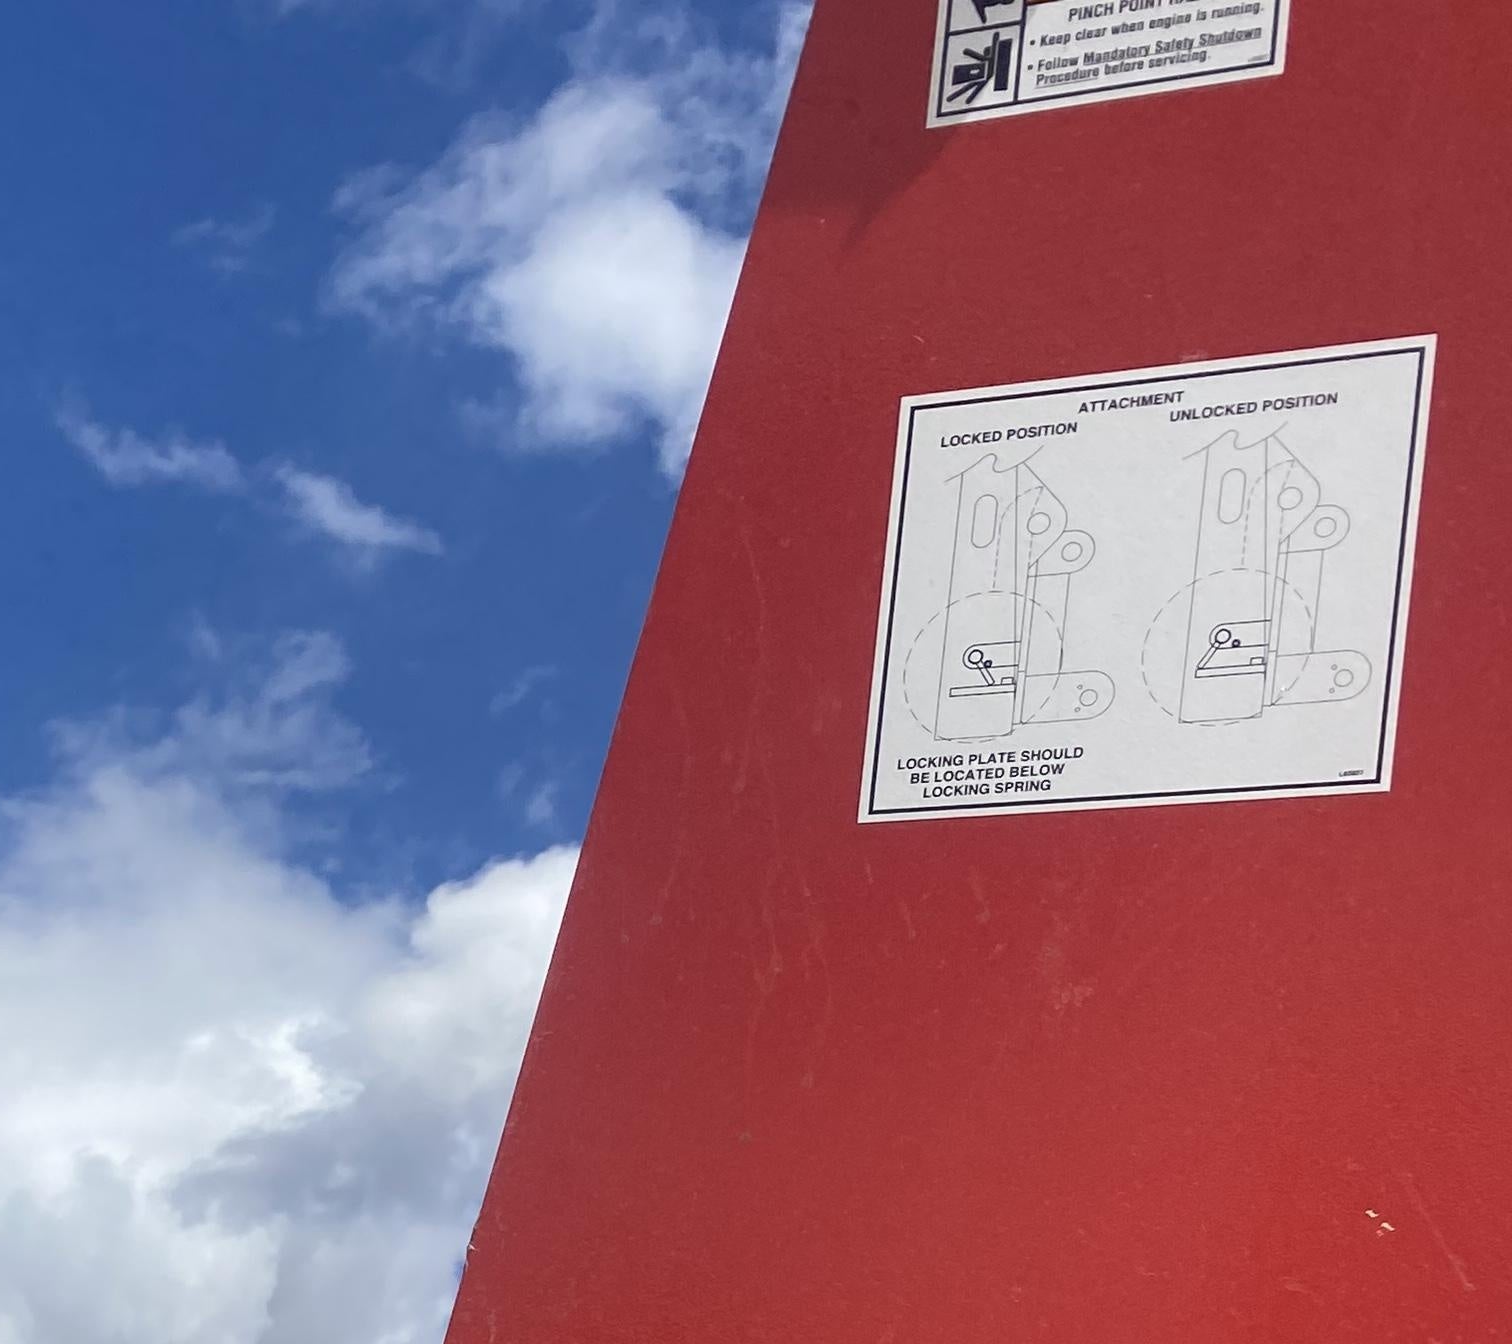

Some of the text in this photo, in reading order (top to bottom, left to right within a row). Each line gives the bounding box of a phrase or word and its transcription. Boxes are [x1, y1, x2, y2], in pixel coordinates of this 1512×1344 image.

[1040, 2, 1264, 47] Keep clear when engine is running.
[1068, 3, 1114, 21] PINCH
[1038, 27, 1262, 72] Follow Mandatory Safety Shutdown
[1036, 50, 1211, 86] Procedure before servicing.
[1078, 391, 1185, 414] ATTACHMENT
[1169, 392, 1338, 422] UNLOCKED POSITION
[941, 421, 1078, 448] LOCKED POSITION
[897, 746, 1084, 770] LOCKING PLATE SHOULD
[910, 763, 1065, 784] BE LOCATED BELOW
[923, 779, 1051, 798] LOCKING SPRING
